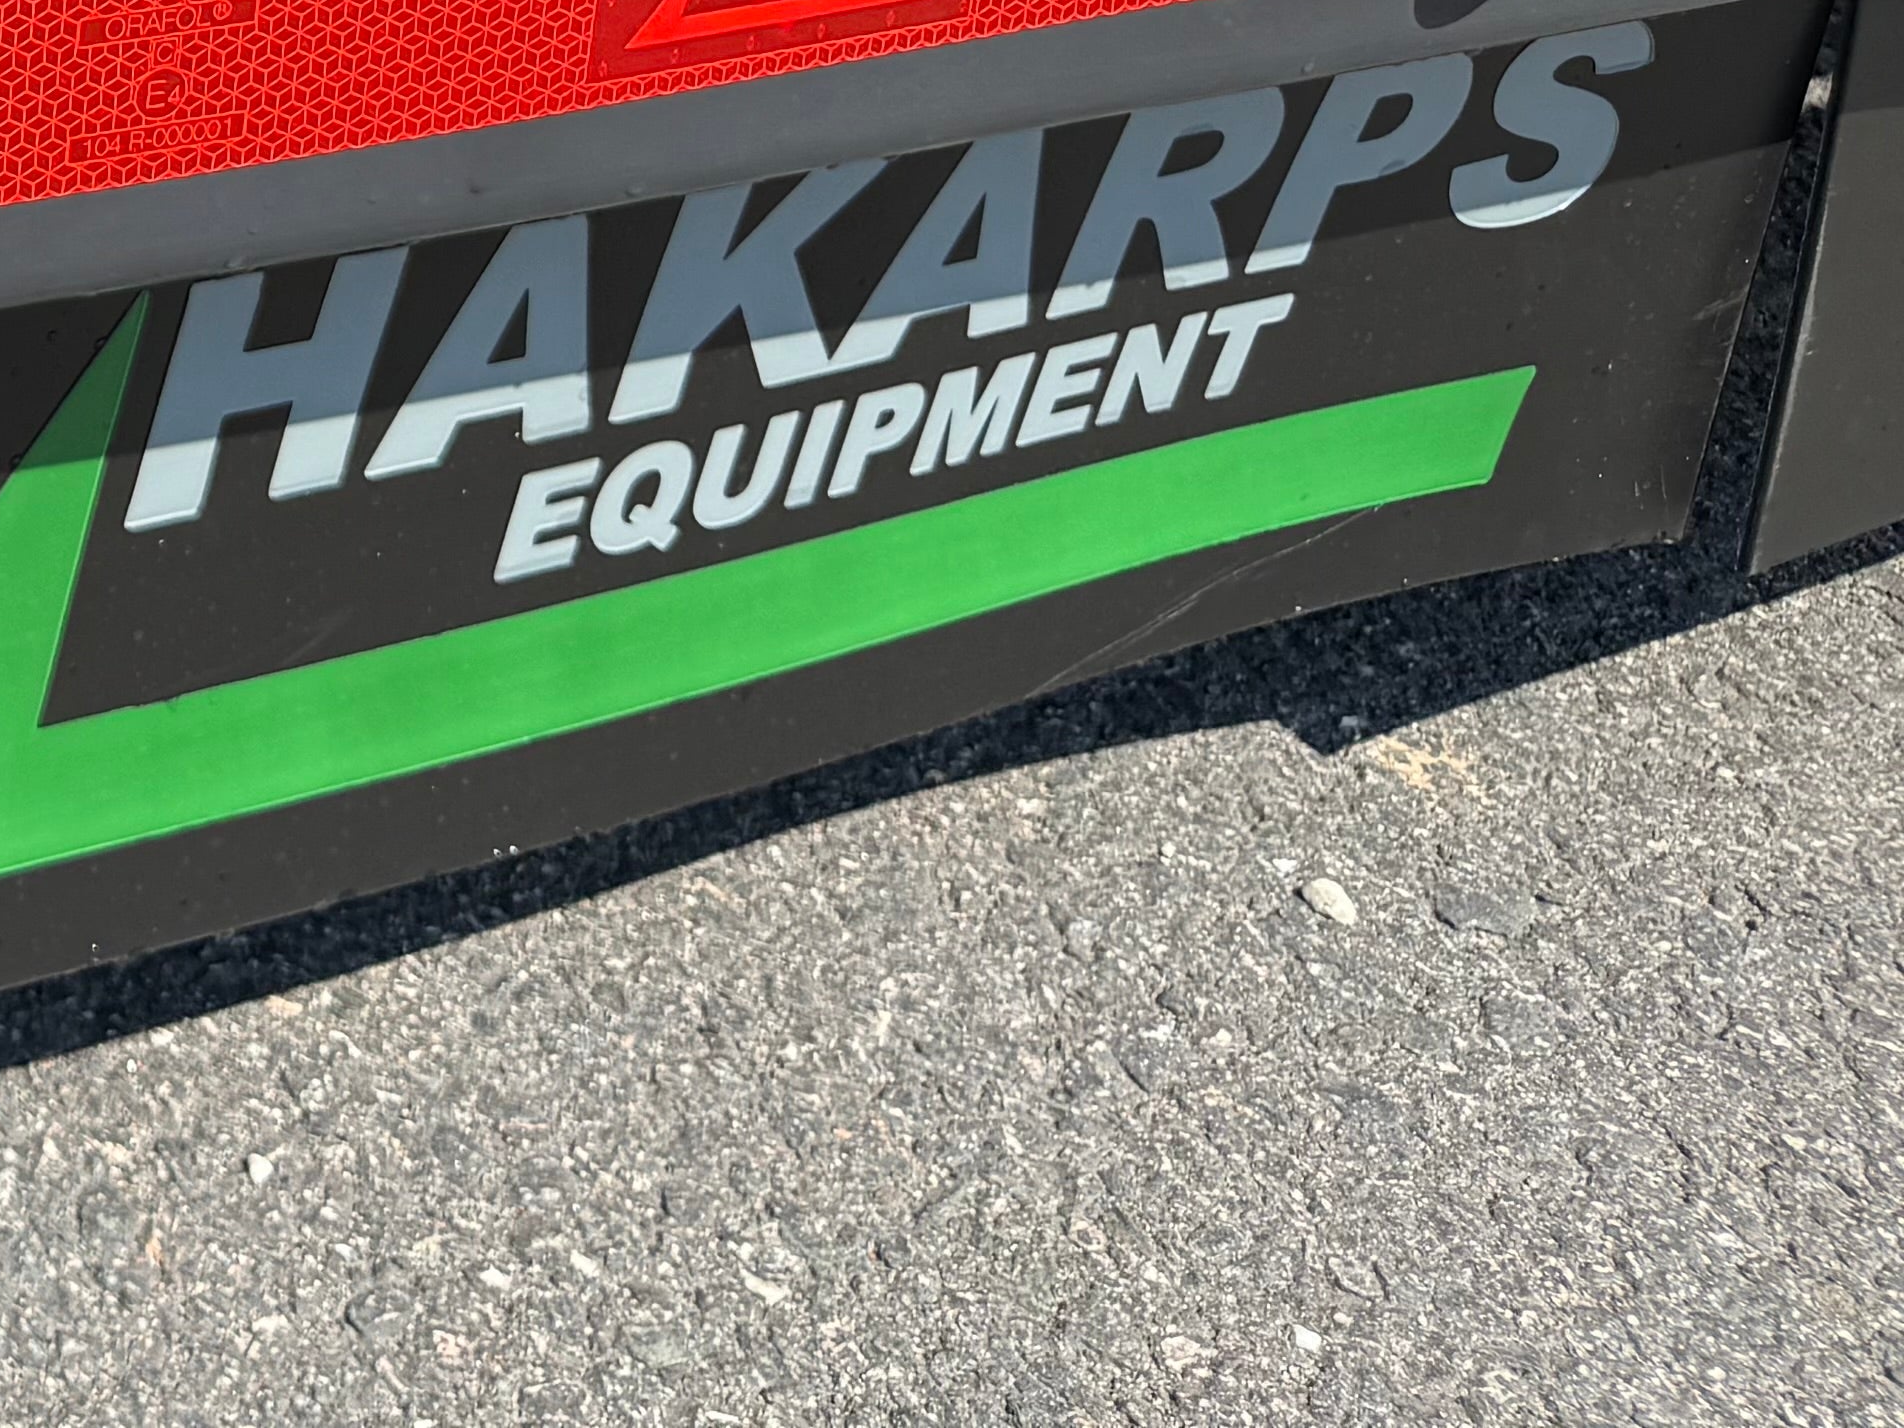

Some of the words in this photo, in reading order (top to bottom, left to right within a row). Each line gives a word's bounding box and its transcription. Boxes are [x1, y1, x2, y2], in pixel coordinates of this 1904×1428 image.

[105, 5, 211, 40] ORAFOL
[146, 80, 181, 109] E4
[83, 133, 120, 158] 104
[128, 116, 232, 152] R-000001
[124, 17, 1656, 532] HAKARPS
[493, 296, 1291, 585] EQUIPMENT
